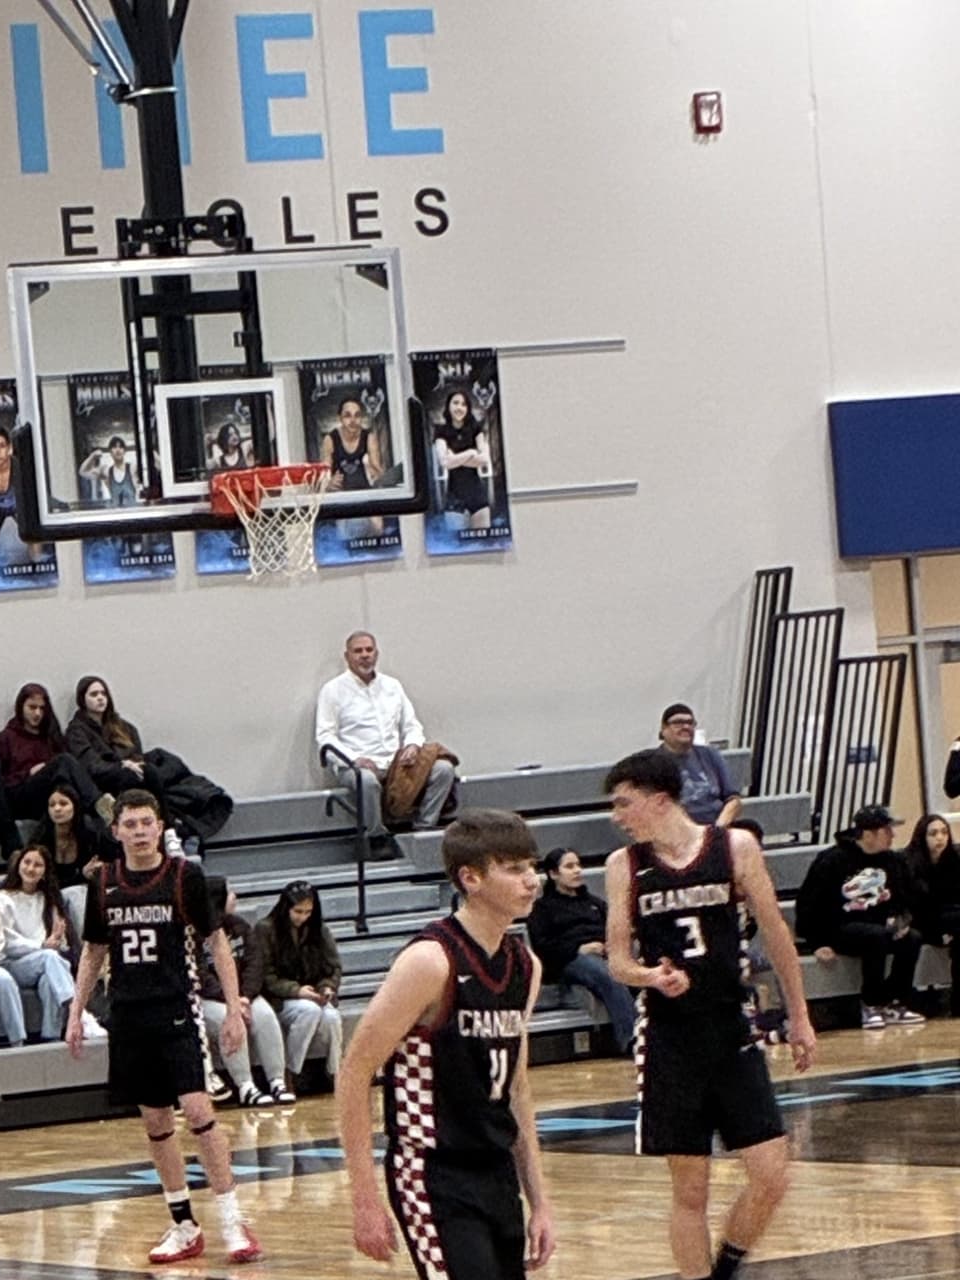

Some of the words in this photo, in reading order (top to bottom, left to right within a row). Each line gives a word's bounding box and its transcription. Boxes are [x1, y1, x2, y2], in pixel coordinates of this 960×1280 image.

[60, 187, 450, 257] ELES
[106, 905, 174, 926] CRANDON
[121, 929, 158, 964] 22
[675, 916, 707, 958] 3
[458, 1009, 526, 1038] CRANDO
